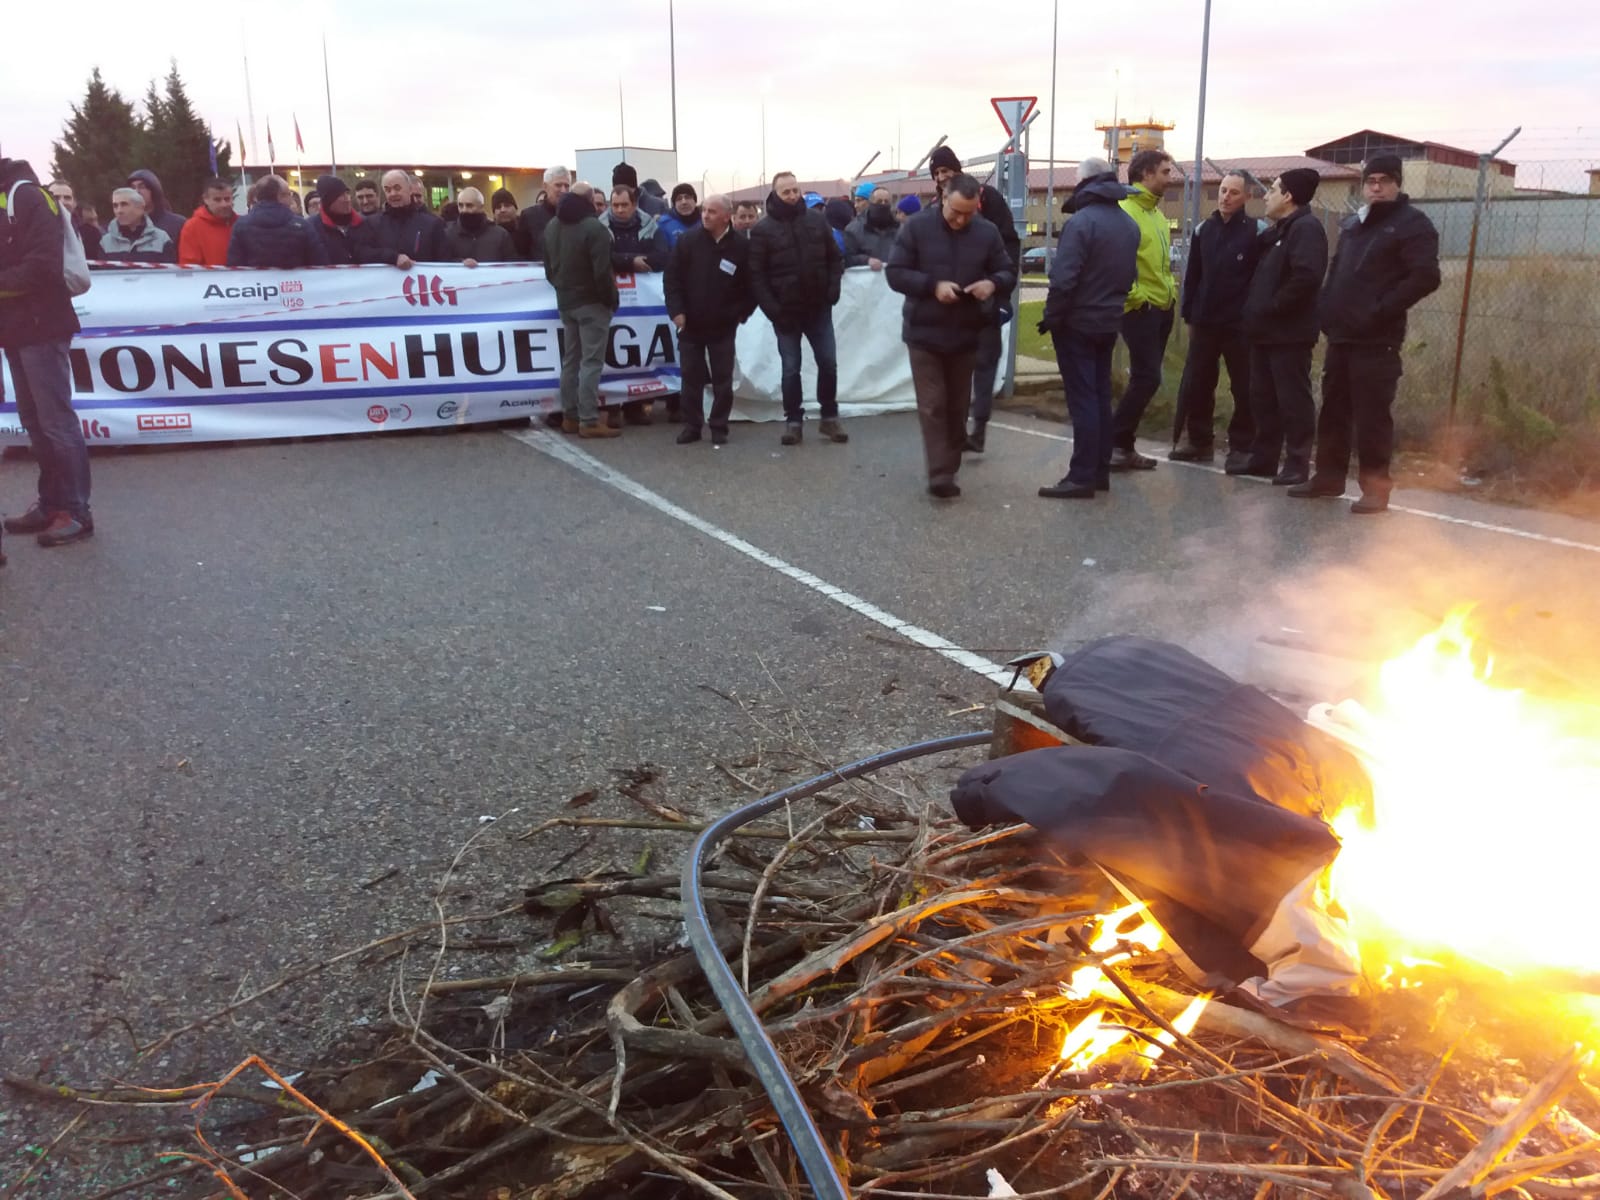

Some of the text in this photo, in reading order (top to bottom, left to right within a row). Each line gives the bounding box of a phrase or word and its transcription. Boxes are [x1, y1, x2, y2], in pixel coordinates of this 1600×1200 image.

[203, 283, 279, 301] Acaip
[403, 274, 458, 306] CIG
[68, 339, 313, 394] IONES
[499, 399, 540, 408] Acaip
[81, 419, 110, 439] IG
[140, 415, 189, 428] CCOO
